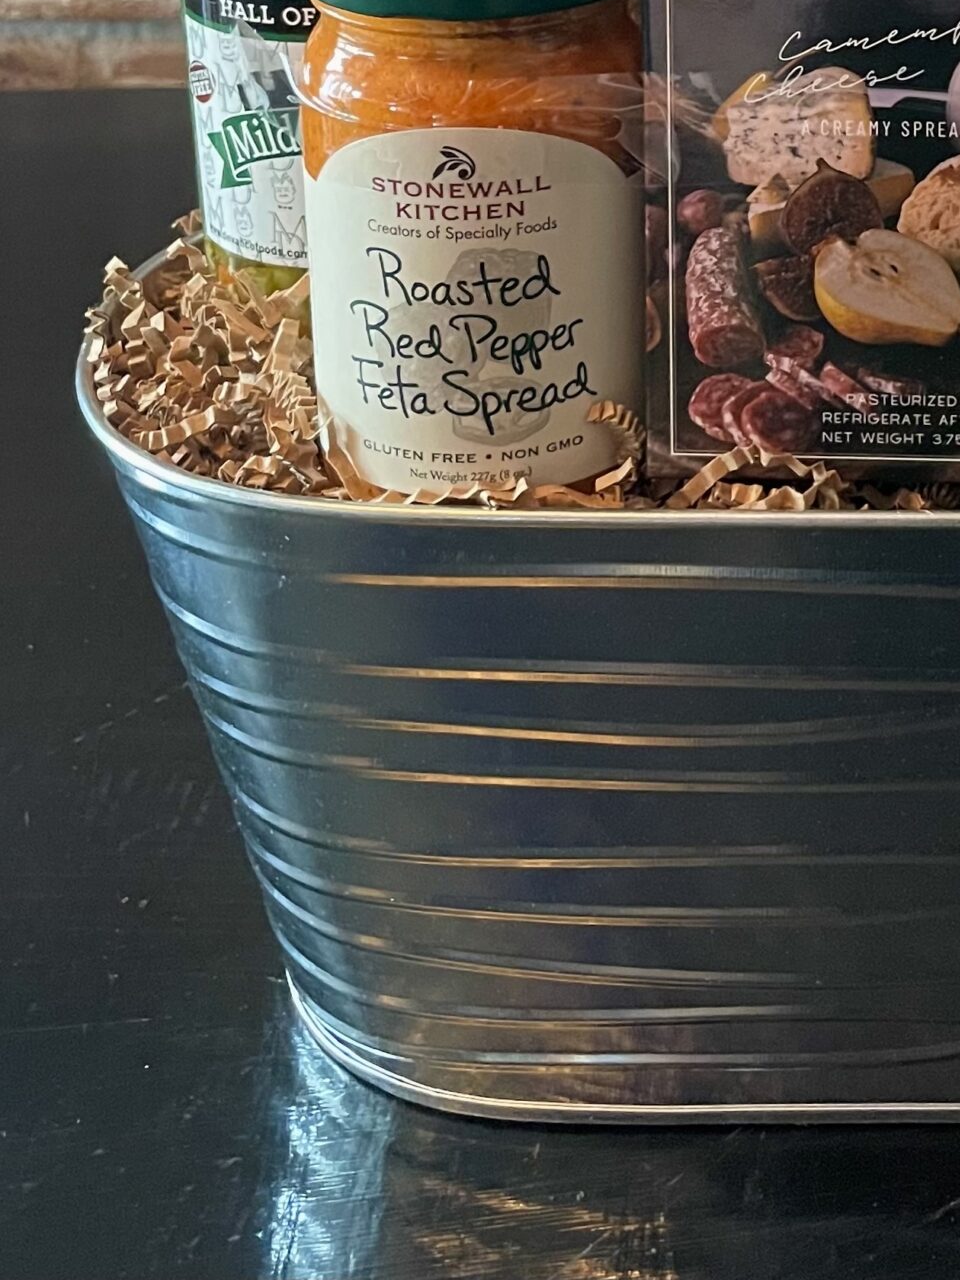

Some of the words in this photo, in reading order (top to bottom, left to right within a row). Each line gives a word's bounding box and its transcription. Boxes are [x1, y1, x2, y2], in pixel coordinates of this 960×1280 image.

[282, 7, 316, 26] OF
[227, 113, 301, 163] Mild
[801, 120, 811, 135] A
[820, 120, 891, 137] CREAMY
[372, 175, 552, 199] STONEWALL
[396, 200, 525, 221] KITCHEN
[368, 219, 422, 238] Creators
[427, 224, 441, 239] of
[446, 224, 512, 243] Specialty
[516, 217, 557, 236] Foods
[366, 246, 561, 306] Roasted
[350, 299, 453, 363] Red
[449, 314, 583, 375] Pepper
[351, 355, 436, 418] Feta
[441, 361, 597, 435] Spread
[846, 393, 957, 408] PASTEURIZED
[822, 411, 931, 426] REFRIGERATE
[821, 431, 852, 444] NET
[861, 432, 924, 445] WEIGHT
[363, 438, 424, 461] GLUTEN
[431, 452, 477, 464] FREE
[501, 445, 539, 462] NON
[546, 435, 584, 453] GMO
[410, 468, 427, 479] Net
[430, 470, 467, 484] Weight
[471, 471, 497, 483] 227g
[499, 469, 510, 480] (8
